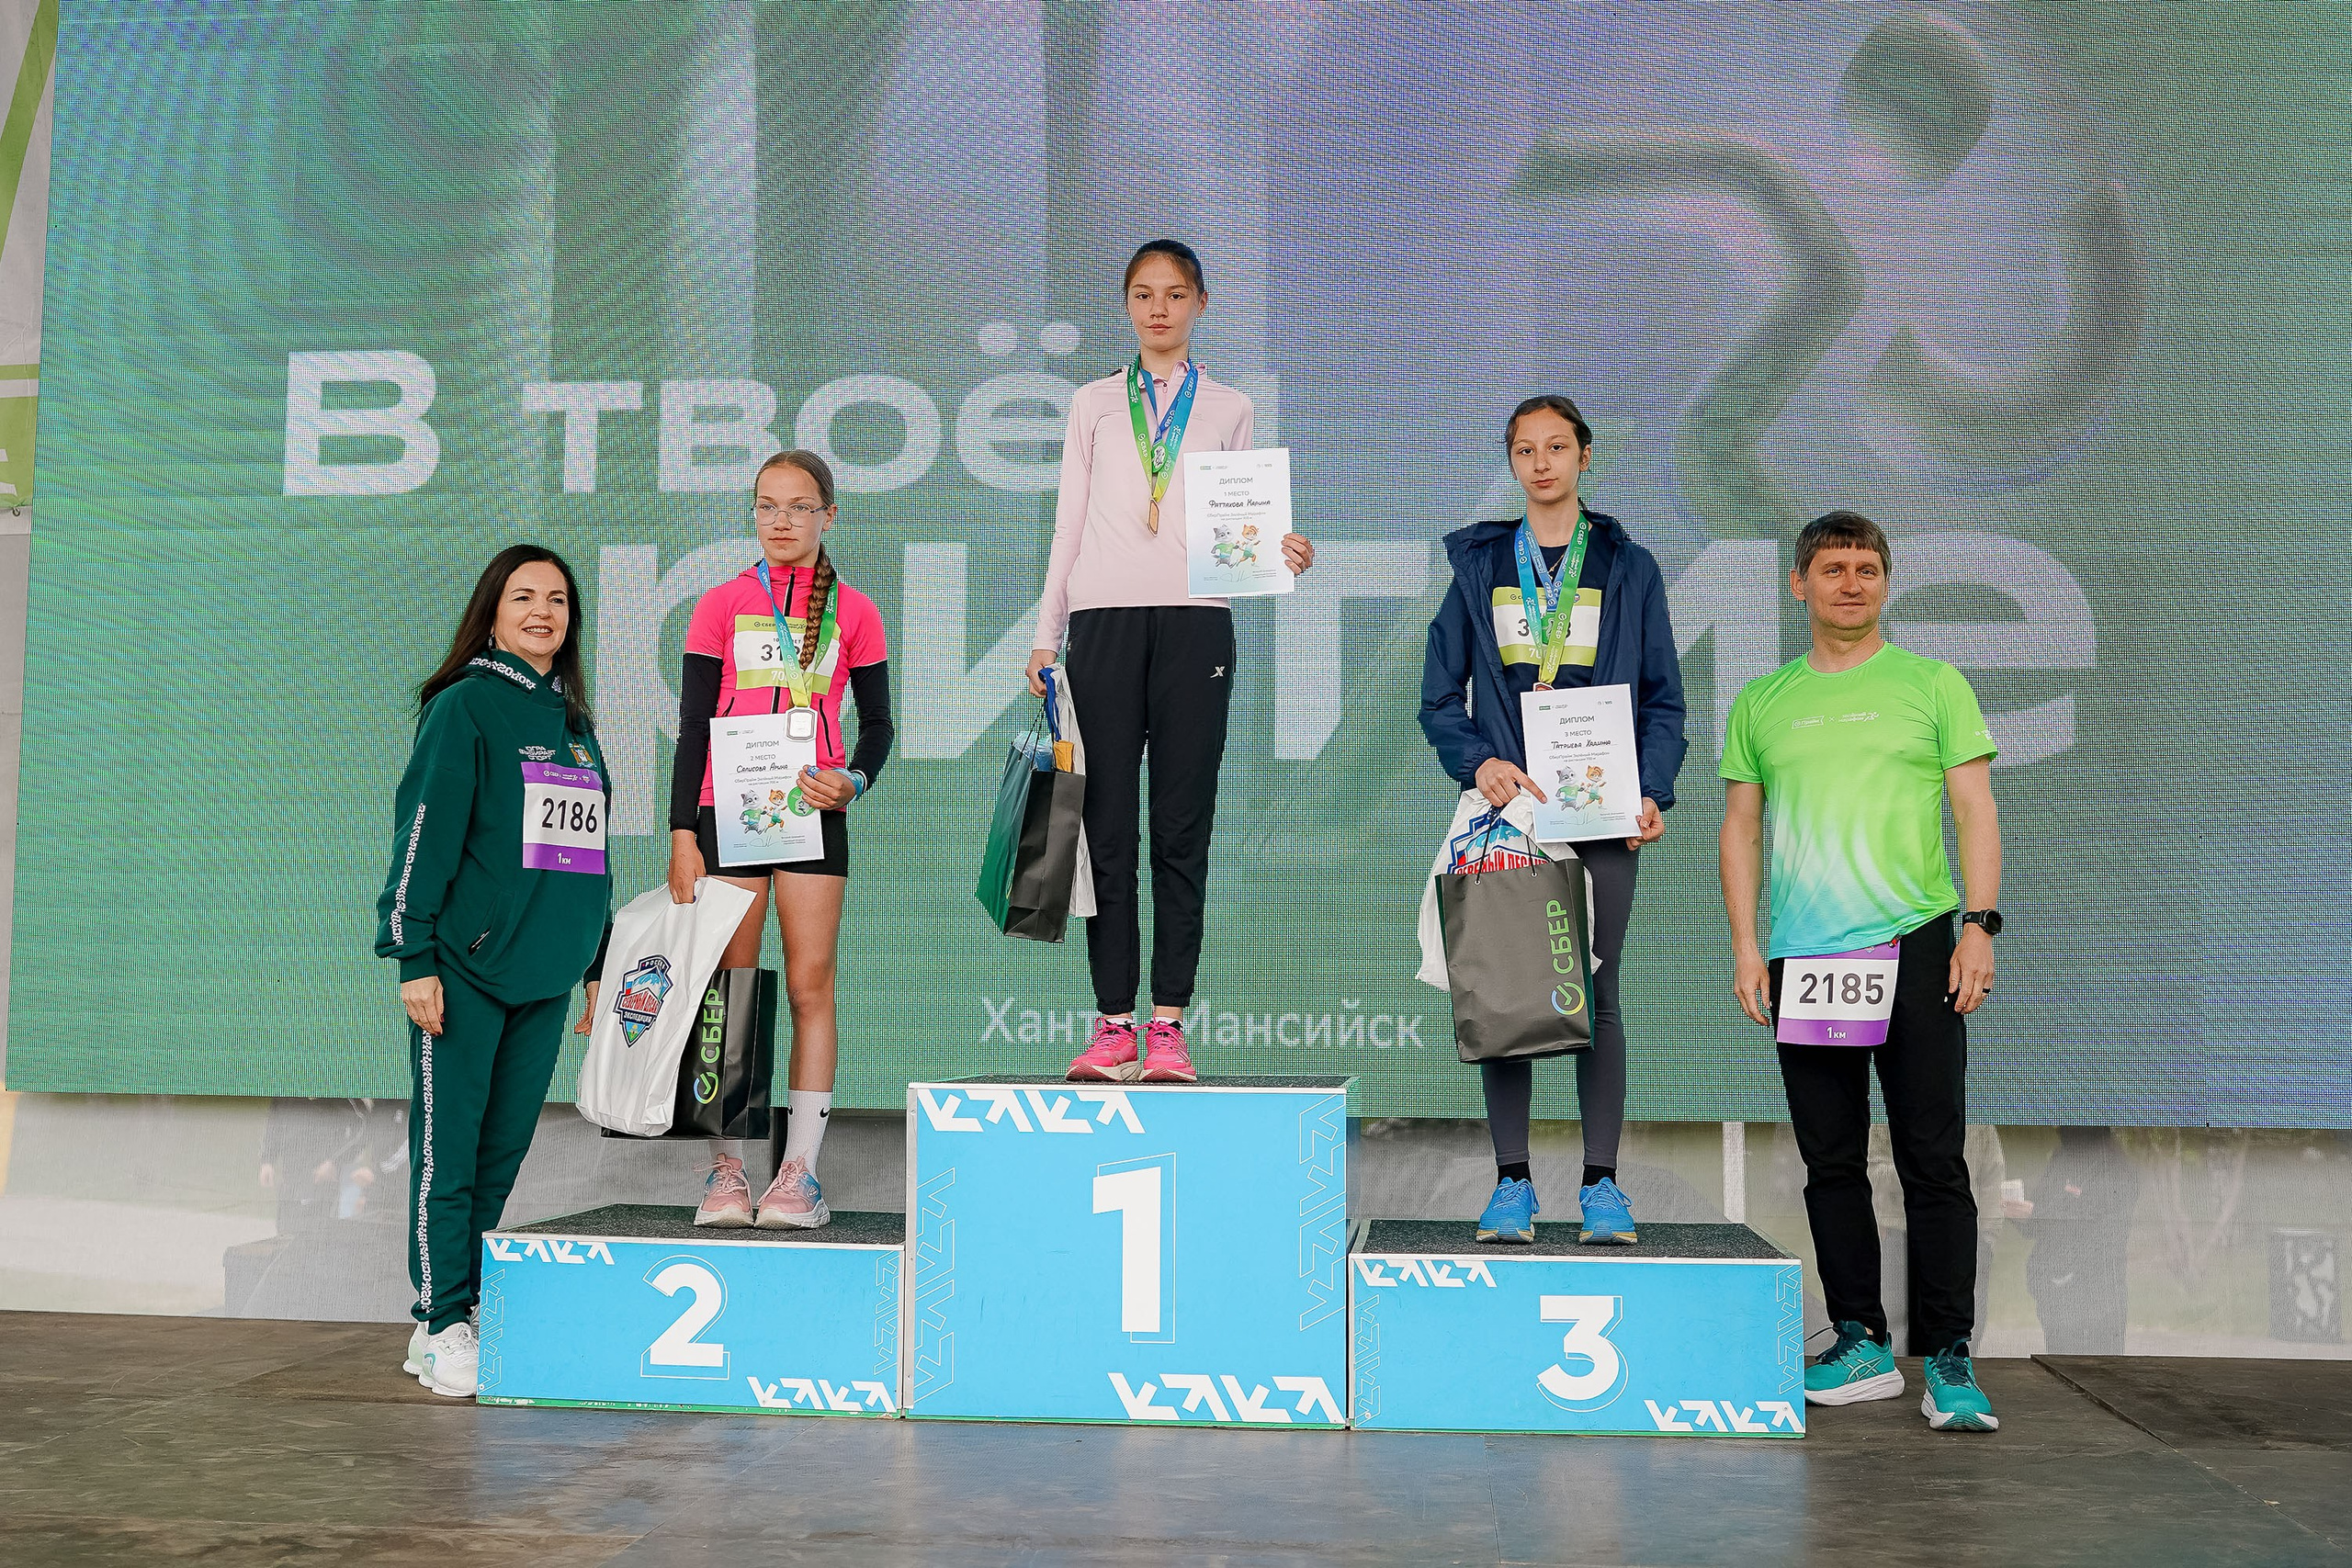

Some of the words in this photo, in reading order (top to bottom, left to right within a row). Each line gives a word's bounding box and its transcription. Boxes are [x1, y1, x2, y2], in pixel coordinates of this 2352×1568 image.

[283, 350, 440, 496] В
[524, 321, 1282, 493] твоё
[1219, 477, 1253, 485] ДИПЛОМ
[745, 740, 779, 750] ДИПЛОМ
[1559, 716, 1595, 725] ДИПЛОМ
[541, 797, 597, 834] 2186
[1546, 899, 1574, 975] СБЕР
[701, 988, 726, 1064] СБЕР
[1799, 973, 1884, 1005] 2185
[1092, 1166, 1162, 1334] 1
[649, 1264, 726, 1367] 2
[1538, 1295, 1621, 1401] 3
